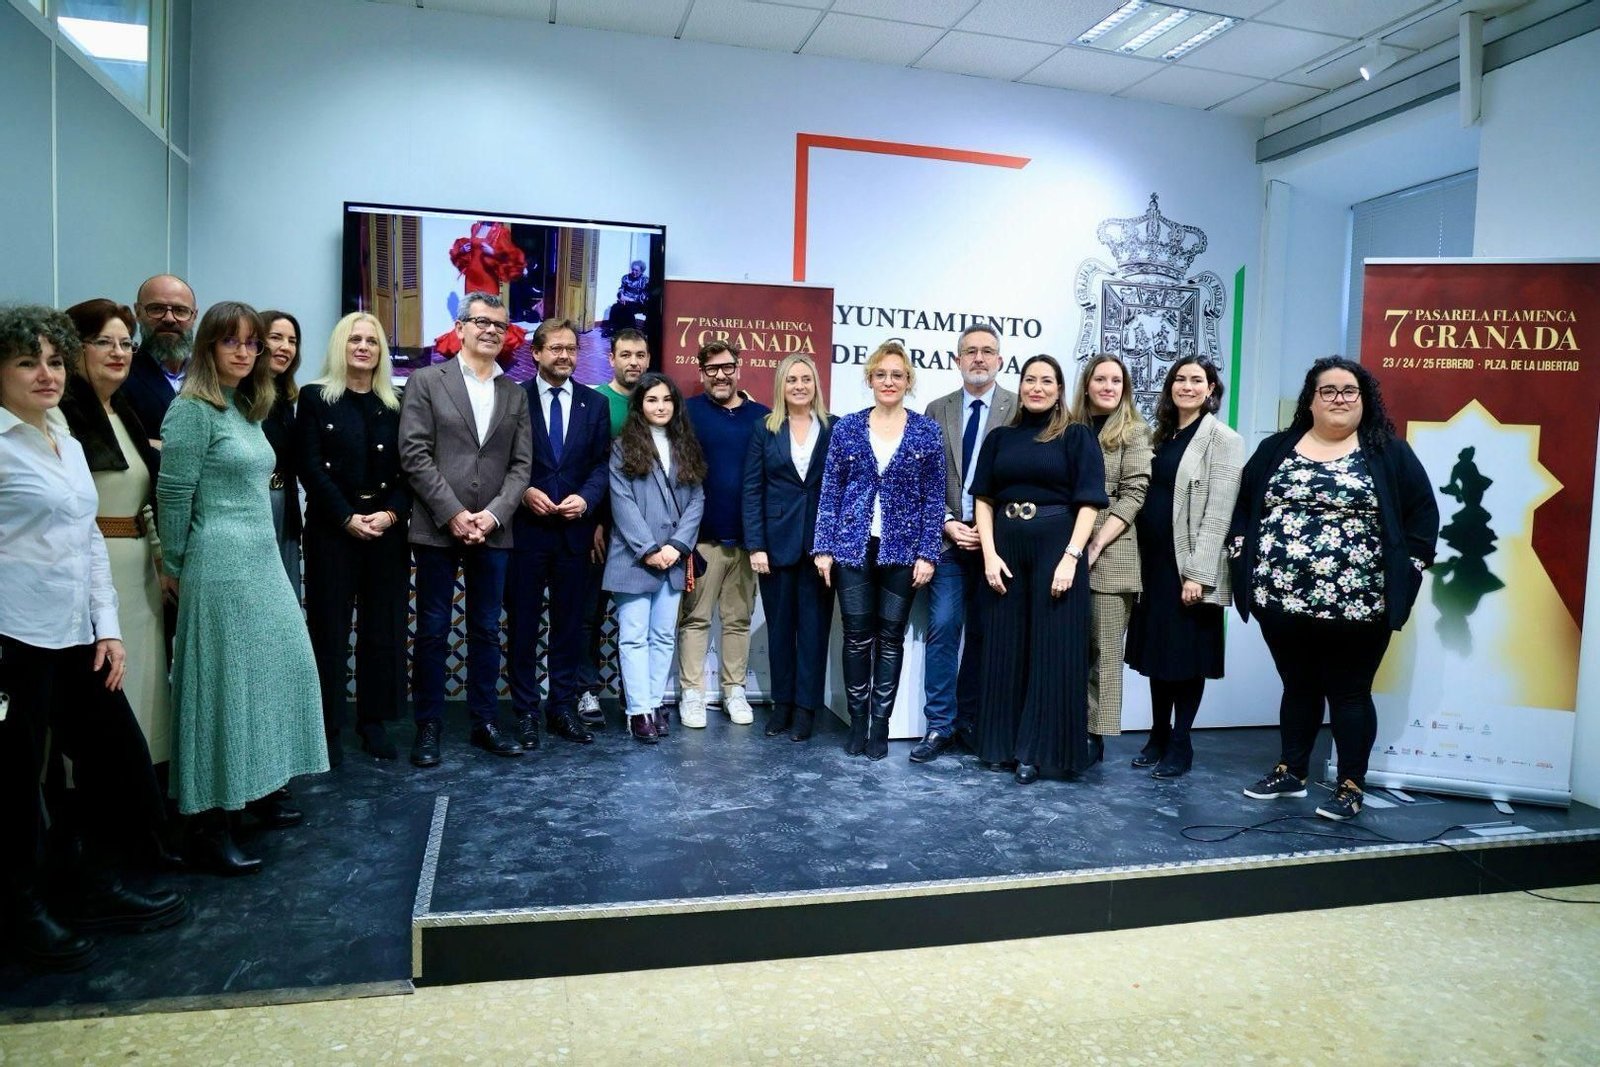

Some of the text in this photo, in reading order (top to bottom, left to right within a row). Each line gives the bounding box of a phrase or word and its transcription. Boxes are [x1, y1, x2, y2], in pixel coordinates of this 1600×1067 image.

[699, 317, 813, 332] PASARELA FLAMENCA
[832, 304, 1043, 339] YUNTAMINTO
[1415, 309, 1577, 322] PASARELA FLAMENCA
[698, 330, 816, 354] GRANADA
[1413, 324, 1580, 351] GRANADA
[832, 343, 868, 365] DE
[1436, 359, 1474, 369] FEBRERO
[1484, 359, 1508, 370] PLZA.
[1511, 360, 1522, 370] DE
[1524, 361, 1535, 371] LA
[1537, 361, 1579, 371] LIBERTAD
